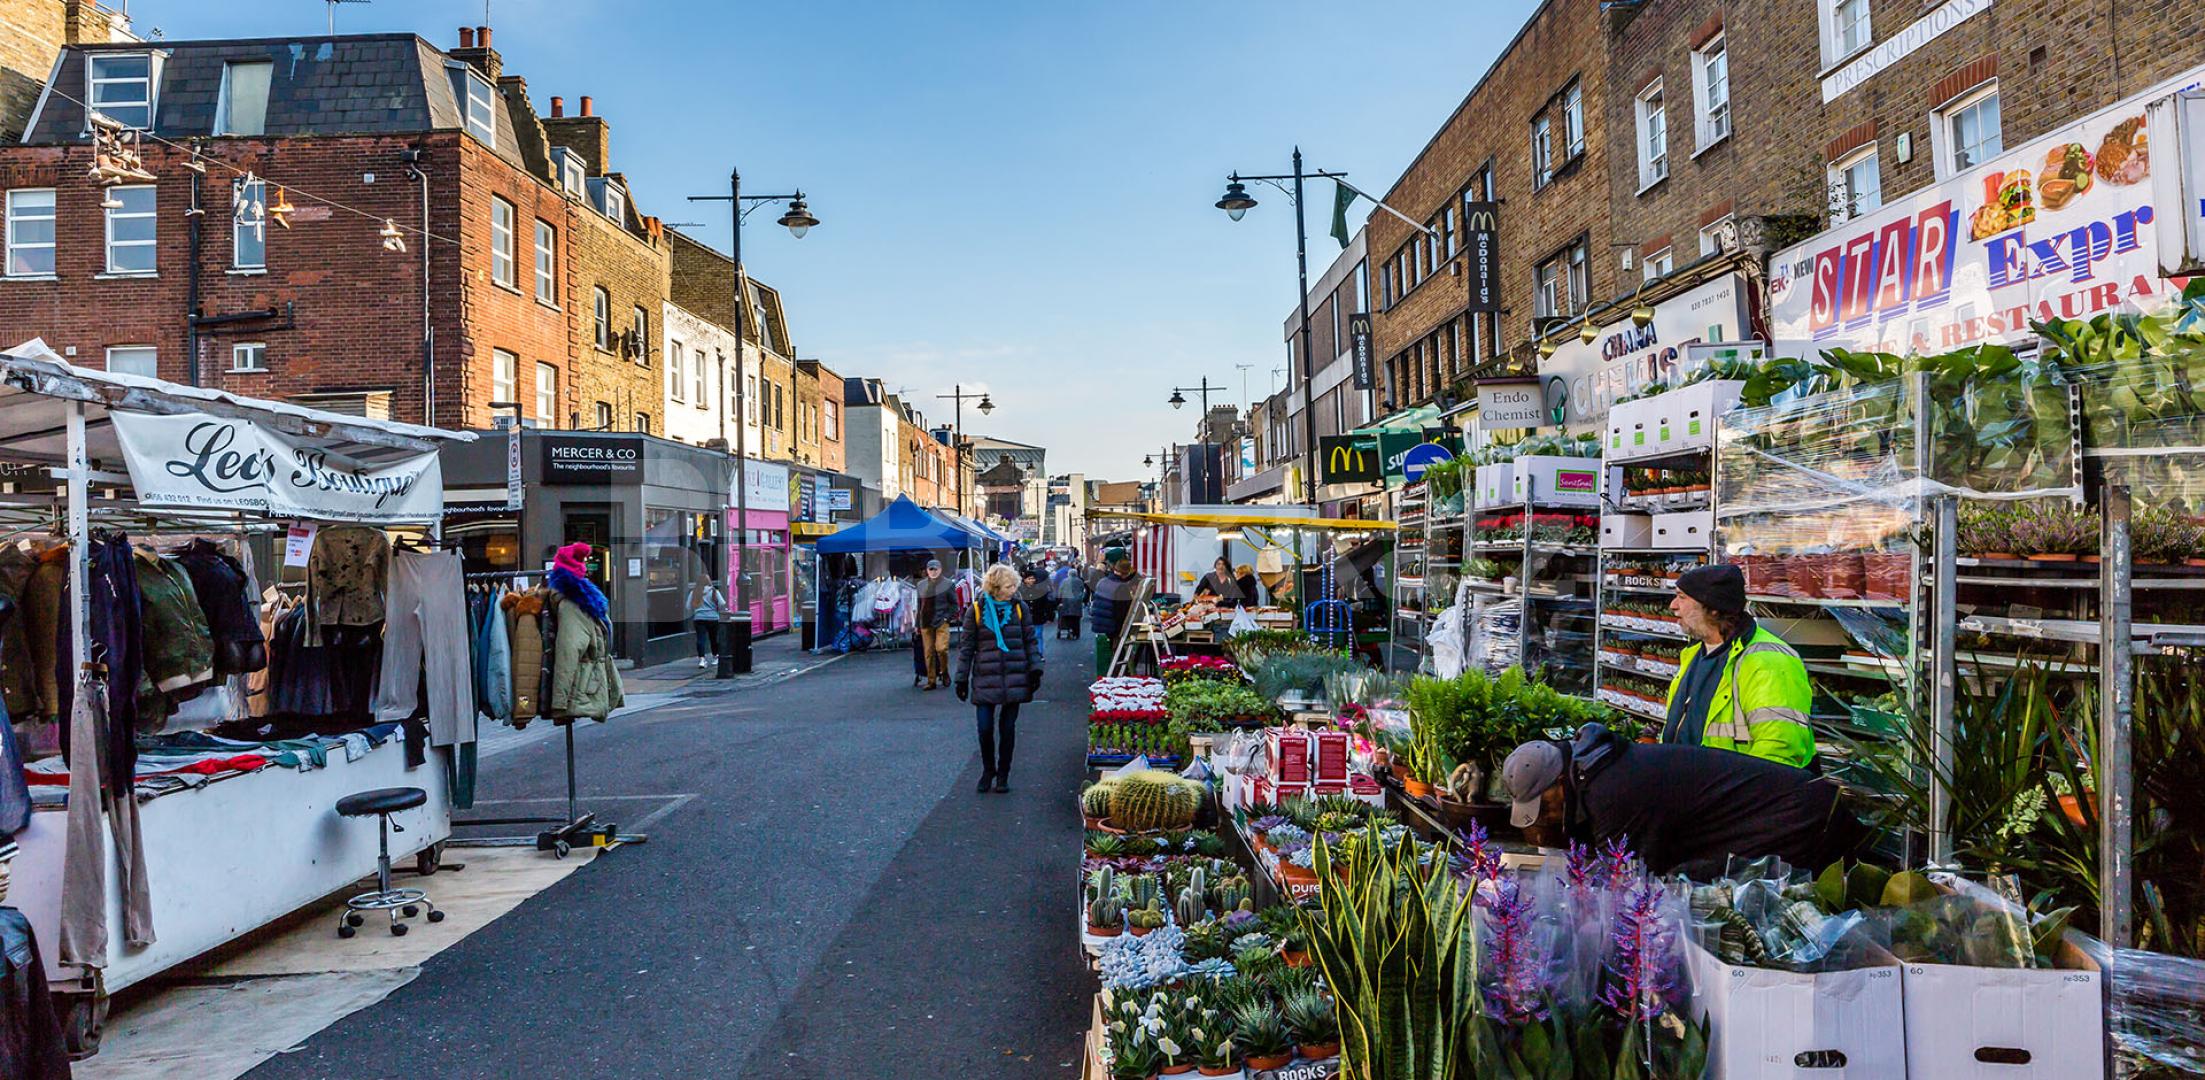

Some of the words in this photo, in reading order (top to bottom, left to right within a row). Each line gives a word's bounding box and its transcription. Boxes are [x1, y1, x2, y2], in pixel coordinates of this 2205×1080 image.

[1834, 0, 1976, 93] PRESCRIPTIONS
[1984, 206, 2155, 290] Expr
[1794, 256, 1814, 280] NEW
[1813, 209, 1948, 328] STAR
[1572, 340, 1700, 416] CHEMIS
[1493, 391, 1529, 404] Endo
[1483, 408, 1541, 422] Chemist
[551, 447, 604, 459] MERCER
[606, 449, 614, 459] &
[617, 449, 636, 459] CO
[166, 422, 276, 493] Leo's
[292, 447, 414, 509] Boutique
[565, 463, 611, 472] neighbourhood's
[611, 463, 636, 471] favourite
[1387, 450, 1409, 471] SU
[487, 504, 506, 512] favour
[1625, 576, 1660, 587] ROCKS
[1292, 883, 1321, 895] pure
[1732, 969, 1744, 978] 60
[1910, 967, 1924, 975] 60
[1278, 1065, 1326, 1080] ROCKS
